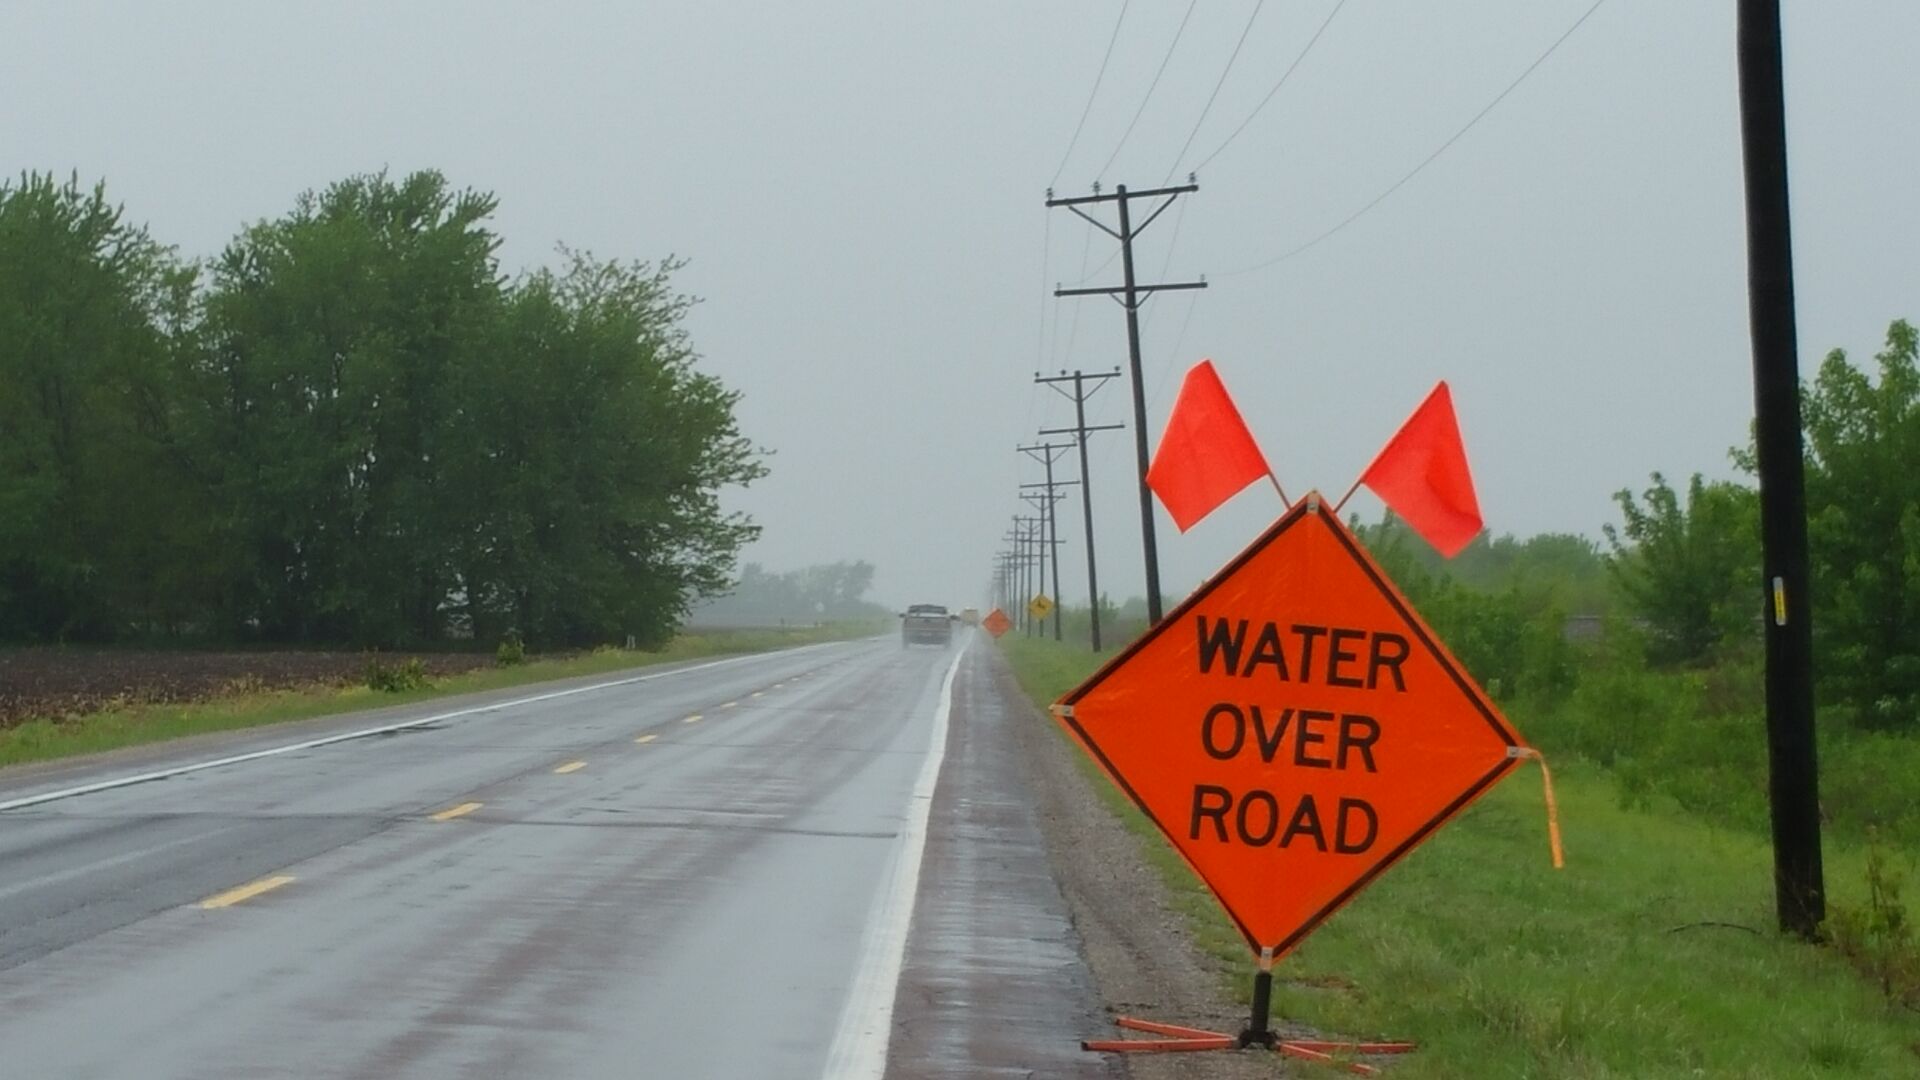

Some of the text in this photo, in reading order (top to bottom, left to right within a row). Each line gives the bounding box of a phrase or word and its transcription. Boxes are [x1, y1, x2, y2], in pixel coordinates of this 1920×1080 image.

[1197, 615, 1411, 692] WATER
[1202, 702, 1381, 773] OVER
[1189, 784, 1379, 855] ROAD
